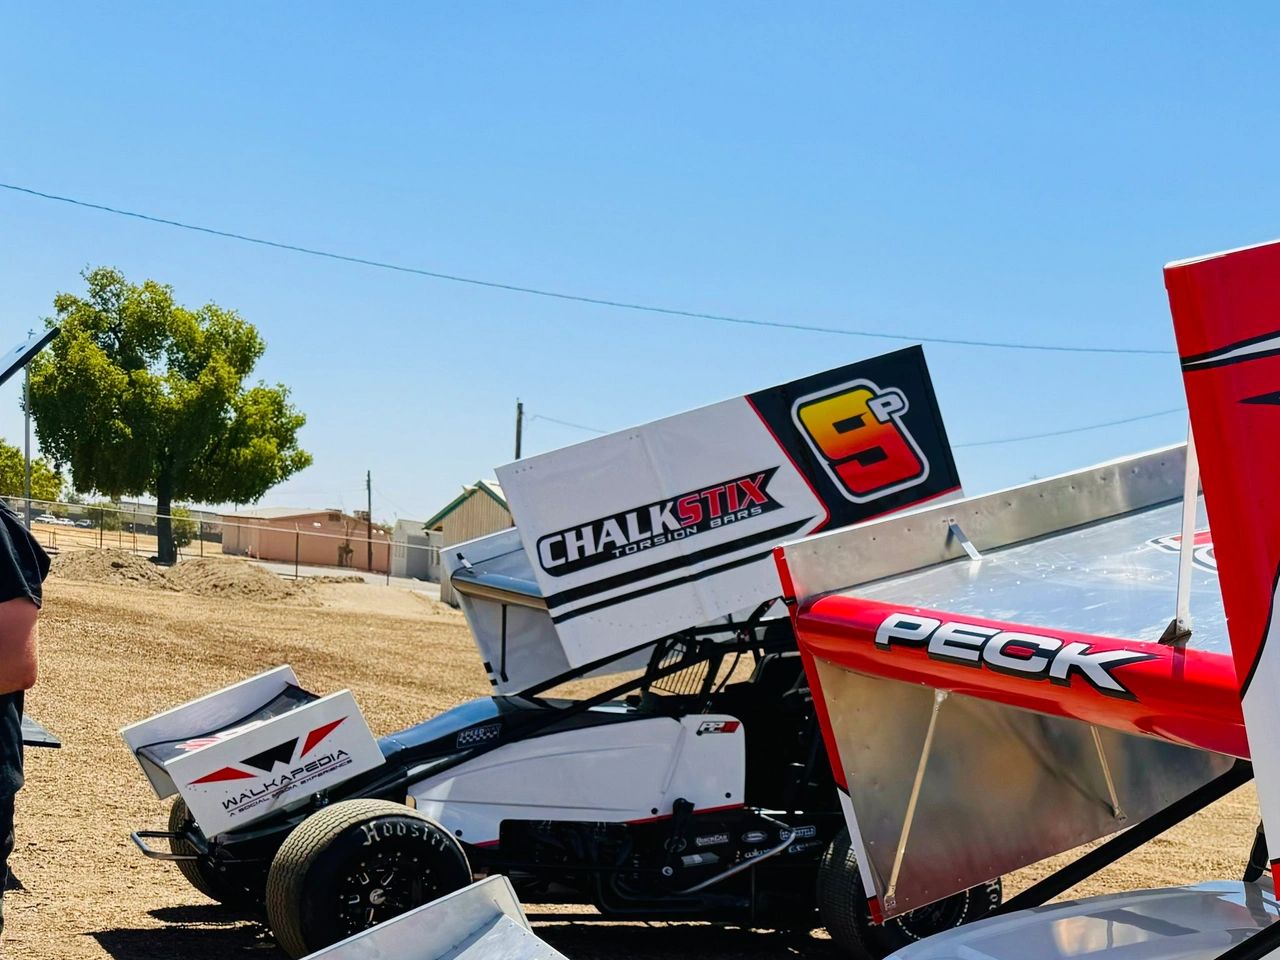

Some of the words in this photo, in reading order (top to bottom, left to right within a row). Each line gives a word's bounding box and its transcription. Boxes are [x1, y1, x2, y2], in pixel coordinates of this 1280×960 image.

[540, 474, 768, 569] CHALKSTIX
[611, 527, 698, 558] TORSION
[710, 506, 763, 528] BARS
[874, 612, 1160, 696] PECK
[222, 750, 349, 810] WALKAPEDIA
